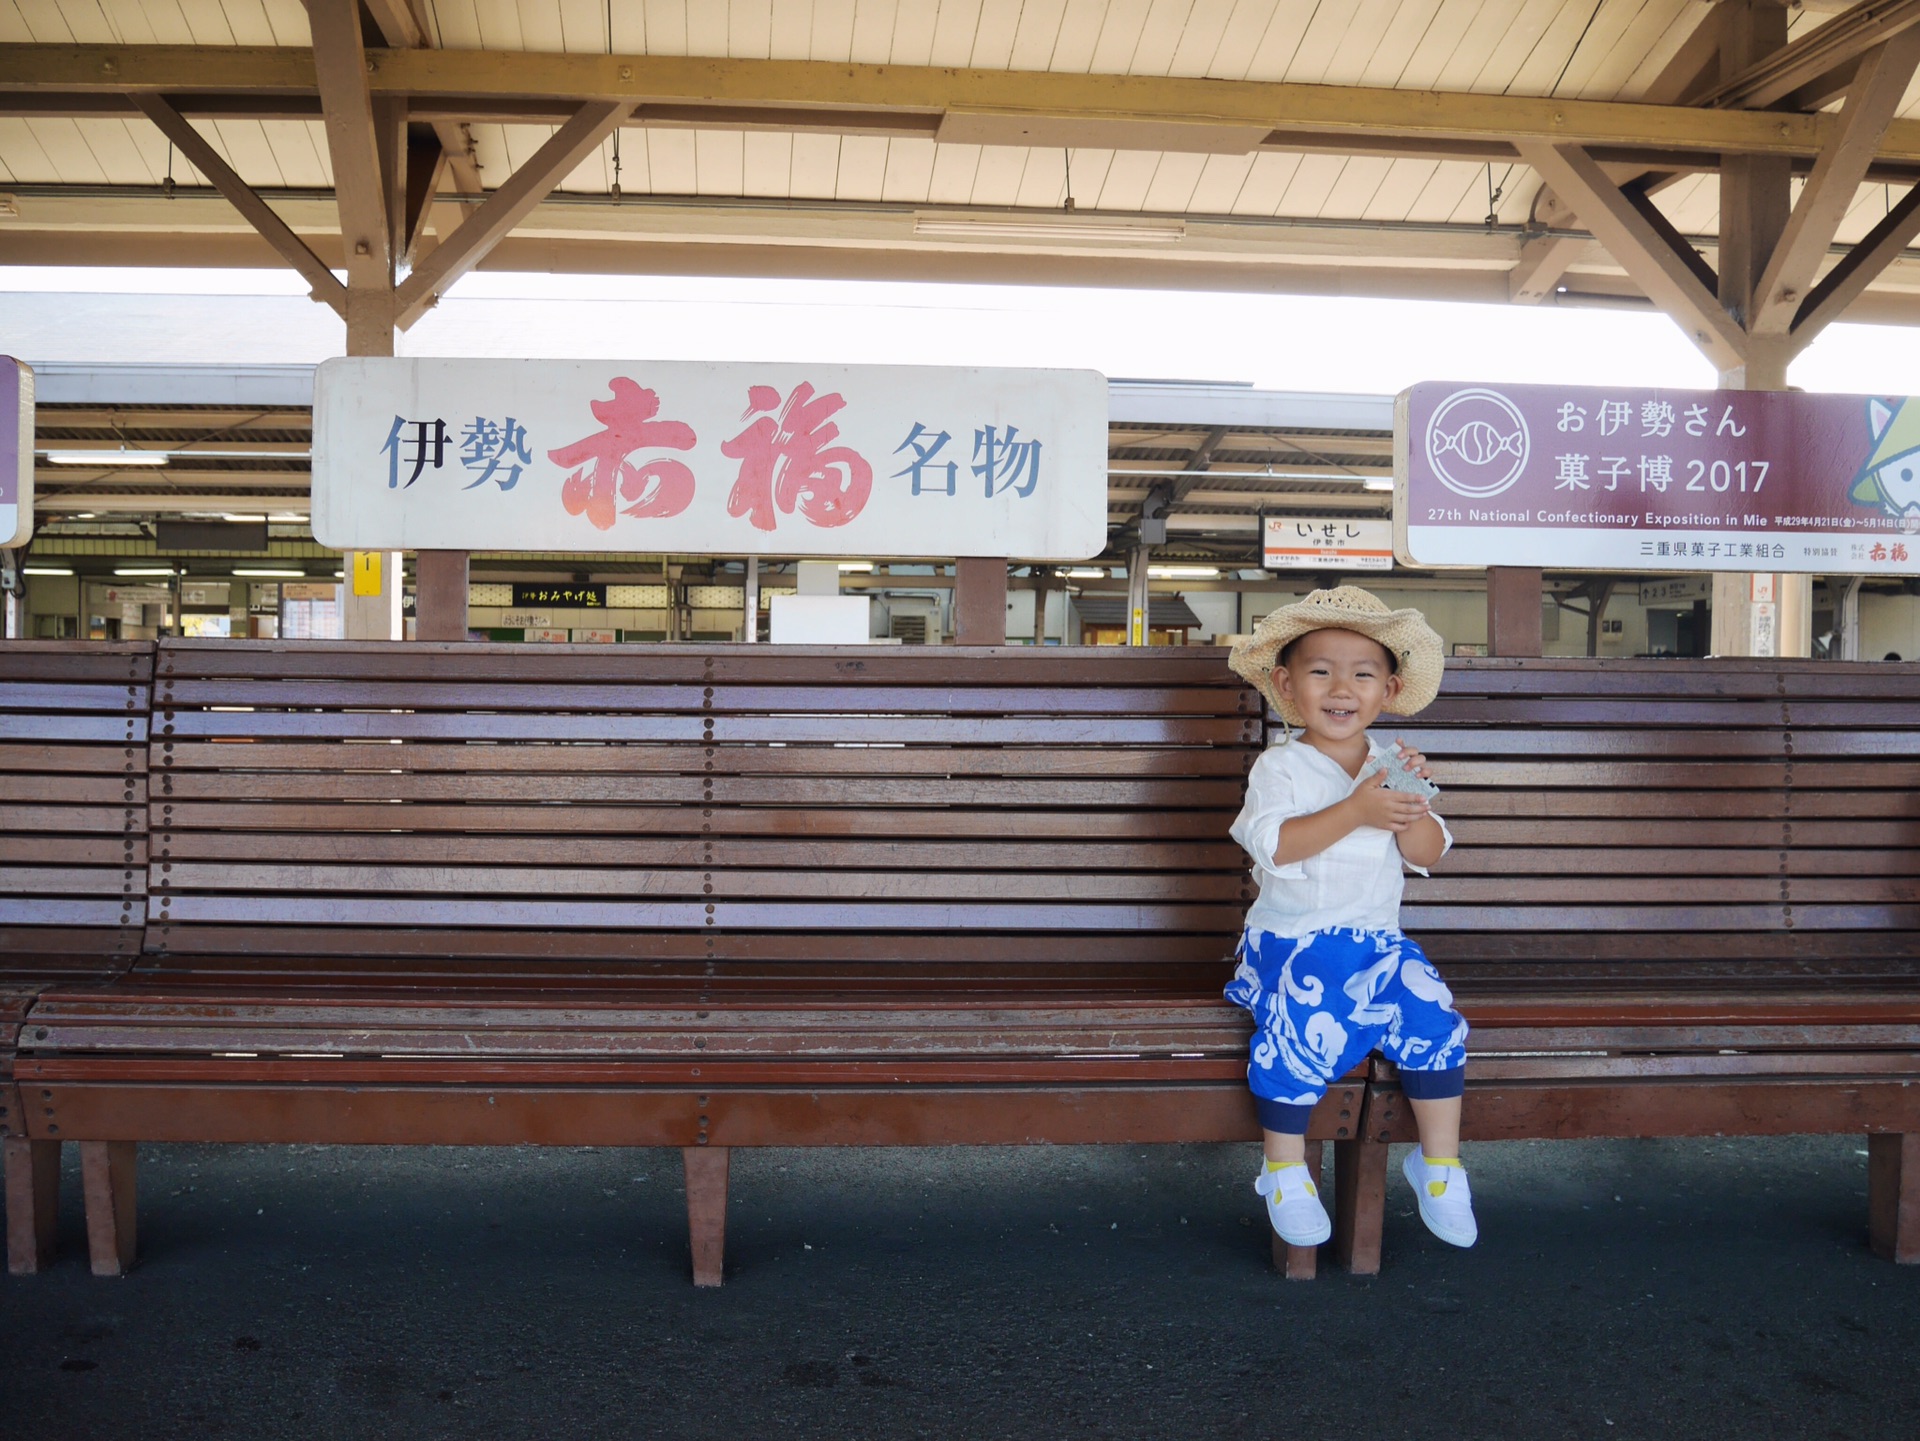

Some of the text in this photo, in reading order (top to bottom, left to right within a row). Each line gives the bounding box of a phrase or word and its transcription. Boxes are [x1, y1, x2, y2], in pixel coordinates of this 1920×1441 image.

[1556, 399, 1747, 437] お伊勢さん
[379, 376, 1043, 531] 伊勢 赤福 名物
[1554, 453, 1770, 493] 菓子博 2017
[1268, 521, 1282, 530] JR
[1428, 509, 1768, 528] 27th National Confectionary Exposition in Mie
[1296, 523, 1361, 538] いせし
[1313, 538, 1345, 547] 伊勢市
[1640, 541, 1786, 559] 三重県菓子工業組合
[1868, 541, 1909, 562] 赤福
